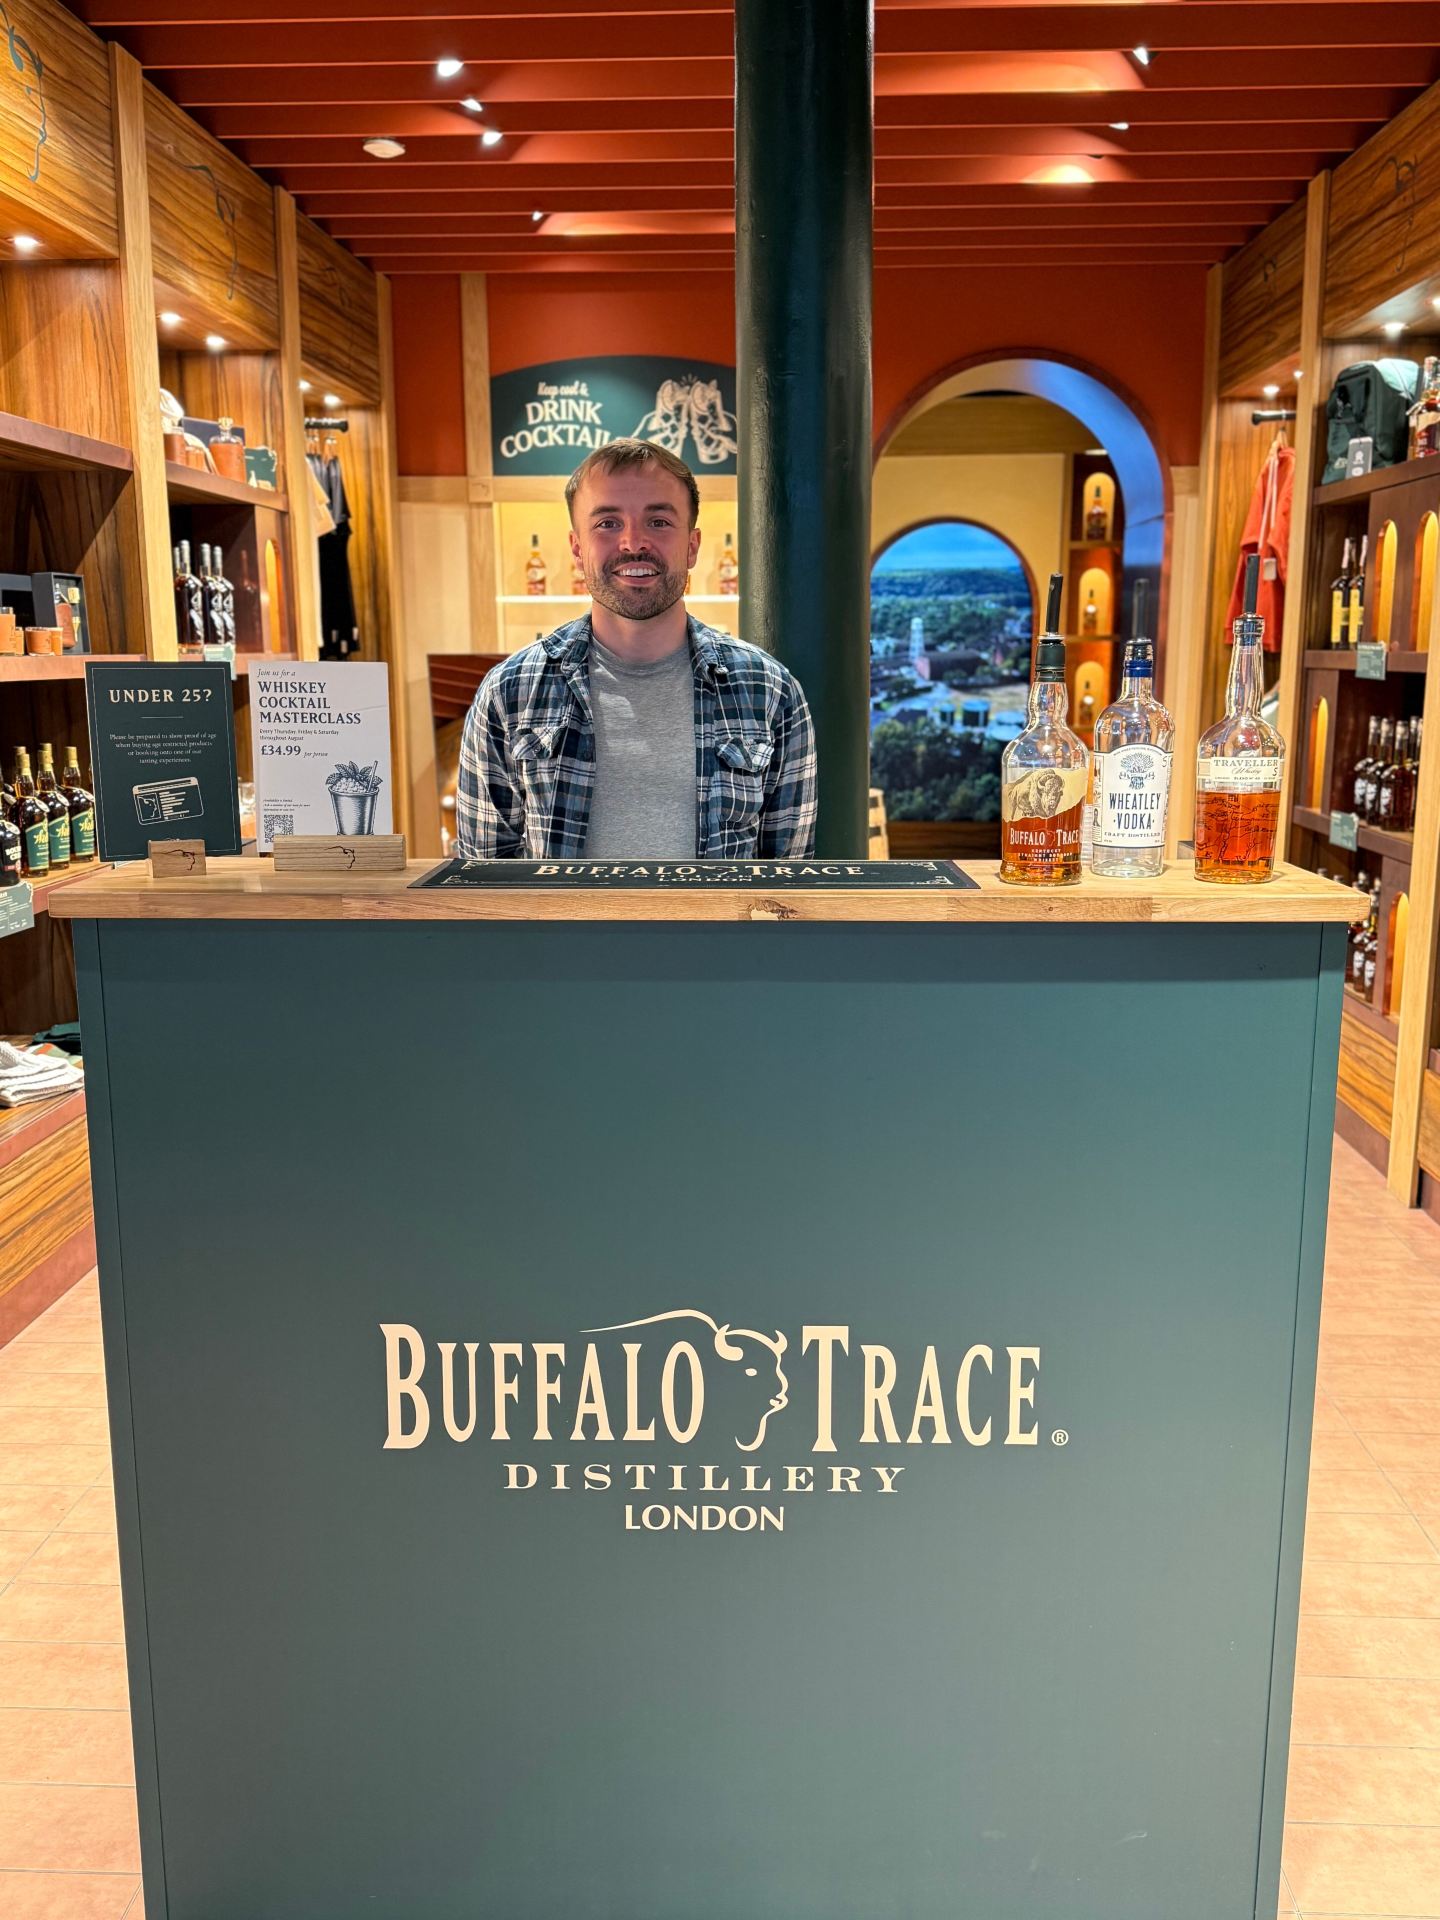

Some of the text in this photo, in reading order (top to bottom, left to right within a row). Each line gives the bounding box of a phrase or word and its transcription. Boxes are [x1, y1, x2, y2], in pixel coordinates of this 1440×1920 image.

[537, 380, 590, 400] Keep cool &
[525, 398, 604, 425] DRINK
[501, 422, 631, 458] COCKTAIL
[257, 669, 270, 677] Join
[280, 669, 290, 678] for
[109, 688, 212, 703] UNDER 25?
[258, 681, 326, 693] WHISKEY
[259, 696, 330, 709] COCKTAIL
[260, 712, 362, 725] MASTERCLASS
[260, 745, 301, 756] £34.99
[1109, 793, 1161, 810] WHEATLEY
[1117, 813, 1152, 830] VODKA
[1010, 828, 1078, 847] BUFFALO TRACE
[532, 864, 865, 876] BUFFALO TRACE
[380, 1324, 704, 1449] BUFFALO
[802, 1326, 1040, 1452] TRACE
[504, 1464, 904, 1493] DISTILLERY
[626, 1504, 785, 1532] LONDON
